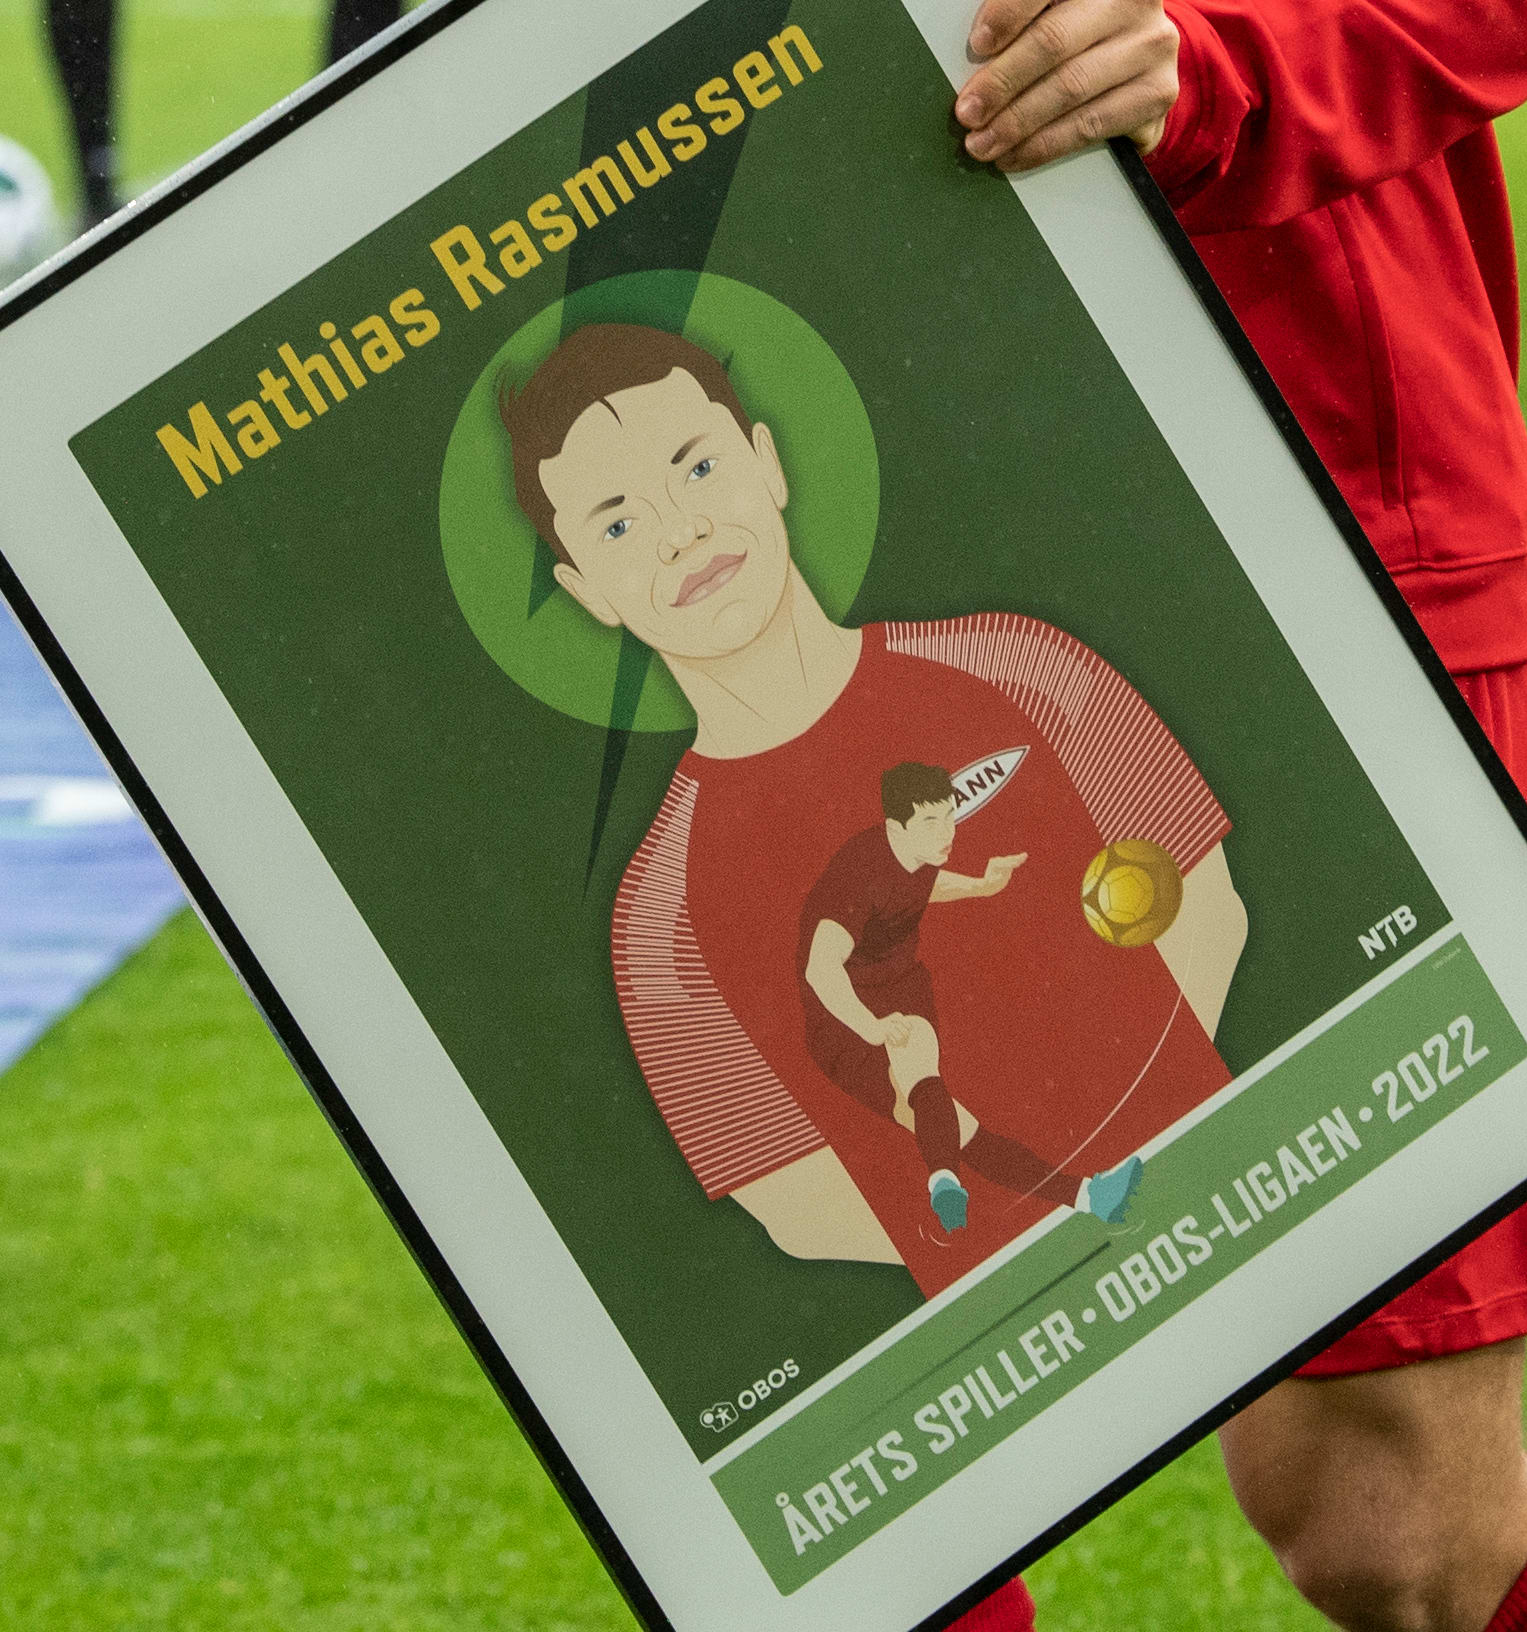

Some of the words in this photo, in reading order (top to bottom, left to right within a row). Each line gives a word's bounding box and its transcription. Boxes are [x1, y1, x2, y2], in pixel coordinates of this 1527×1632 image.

[155, 287, 442, 500] Mathias
[429, 24, 824, 311] Rasmussen
[1358, 905, 1418, 961] NTB
[737, 1358, 801, 1410] OBOS
[774, 1430, 919, 1556] ÅRETS
[913, 1309, 1086, 1455] SPILLER
[1095, 1106, 1363, 1323] OBOS-LIGAEN
[1371, 1015, 1491, 1123] 2022
